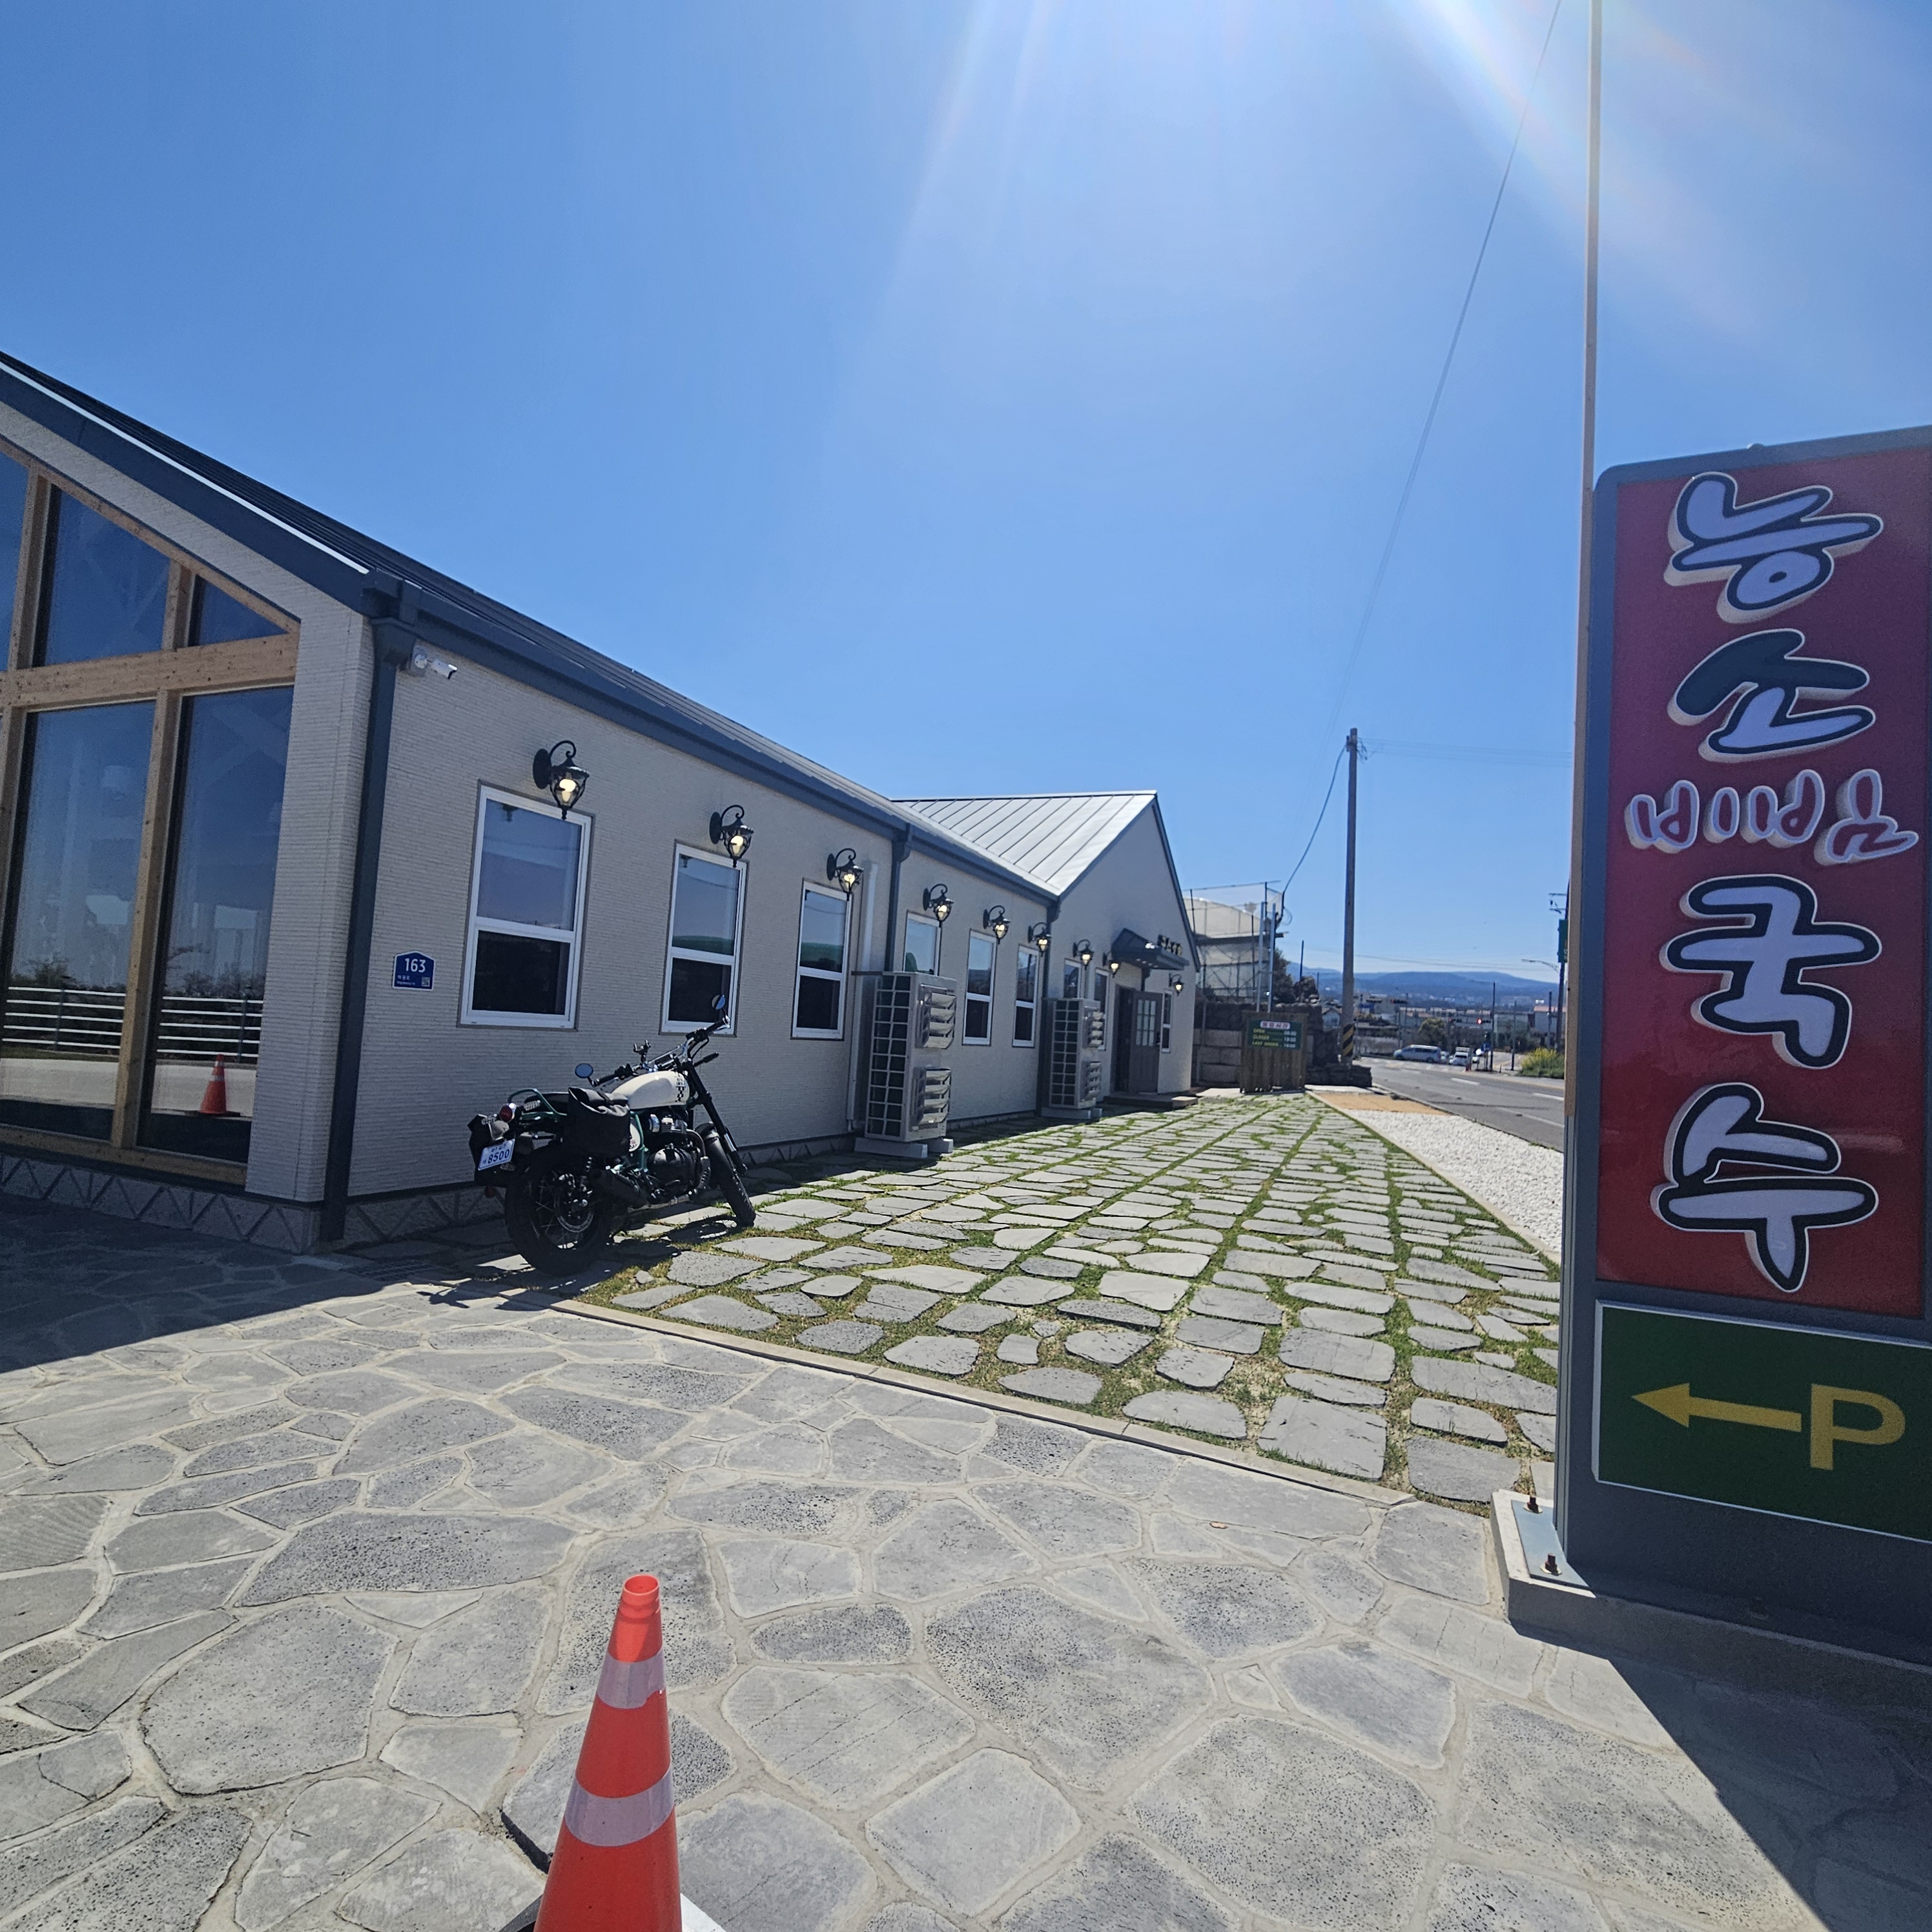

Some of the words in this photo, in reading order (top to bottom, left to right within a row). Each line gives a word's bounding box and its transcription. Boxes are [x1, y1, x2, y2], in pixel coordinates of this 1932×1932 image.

[404, 958, 426, 973] 163
[1651, 873, 1882, 1292] 국수
[488, 1149, 510, 1164] 8500
[1809, 1382, 1906, 1472] P
